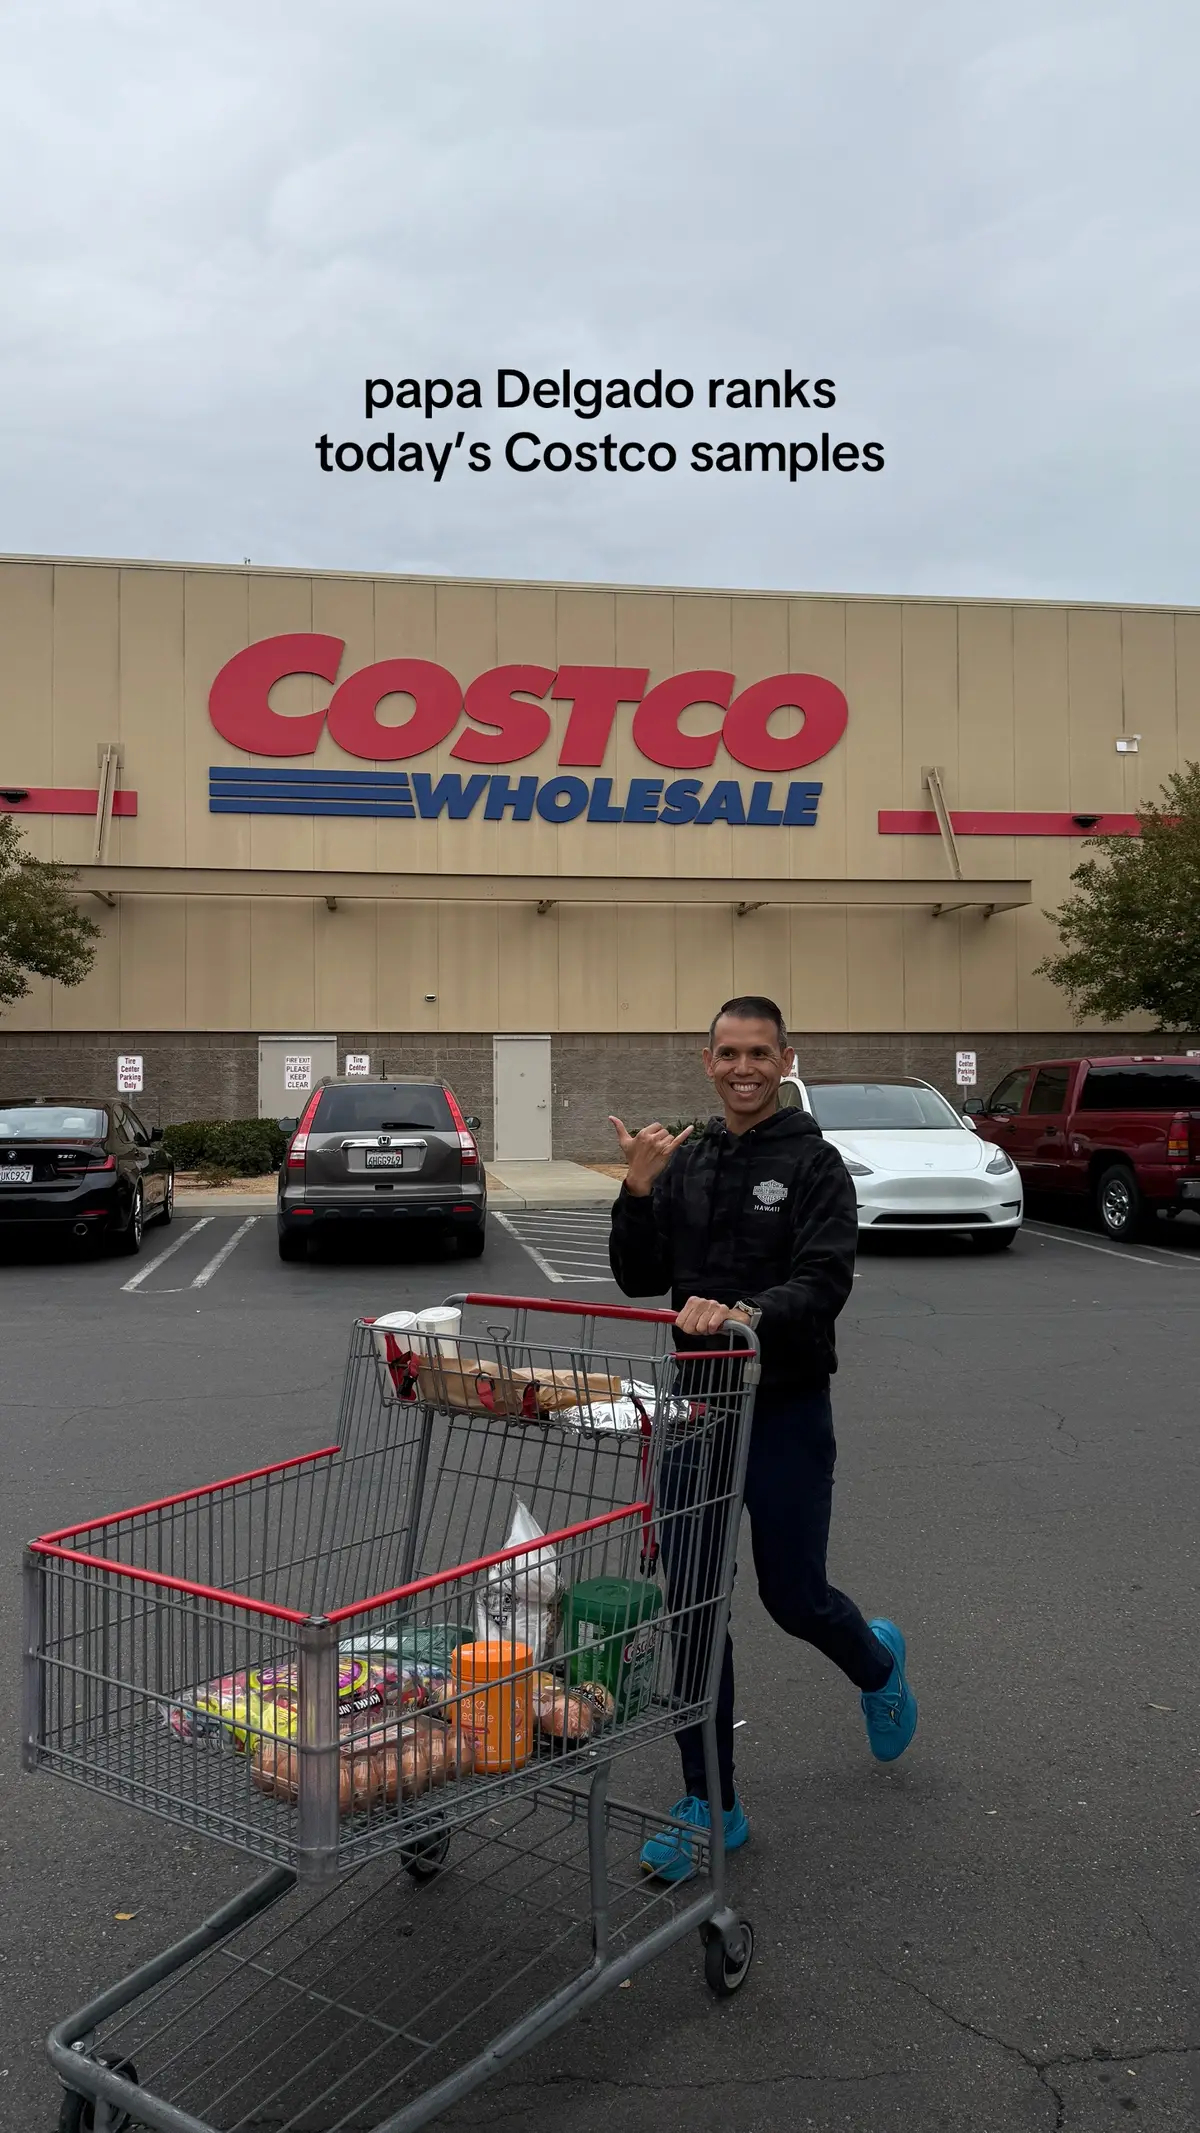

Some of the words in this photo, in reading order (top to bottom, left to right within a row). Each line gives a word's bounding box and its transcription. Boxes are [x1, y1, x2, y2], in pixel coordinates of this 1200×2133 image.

[208, 633, 849, 772] COSTCO
[411, 772, 824, 826] WHOLESALE
[352, 1056, 363, 1064] Tire
[286, 1065, 310, 1073] PLEASE
[348, 1063, 367, 1071] Center
[957, 1067, 975, 1076] Parking
[119, 1073, 142, 1082] Parking
[961, 1075, 971, 1083] Only
[124, 1081, 137, 1090] Only
[754, 1204, 780, 1213] HAWAII
